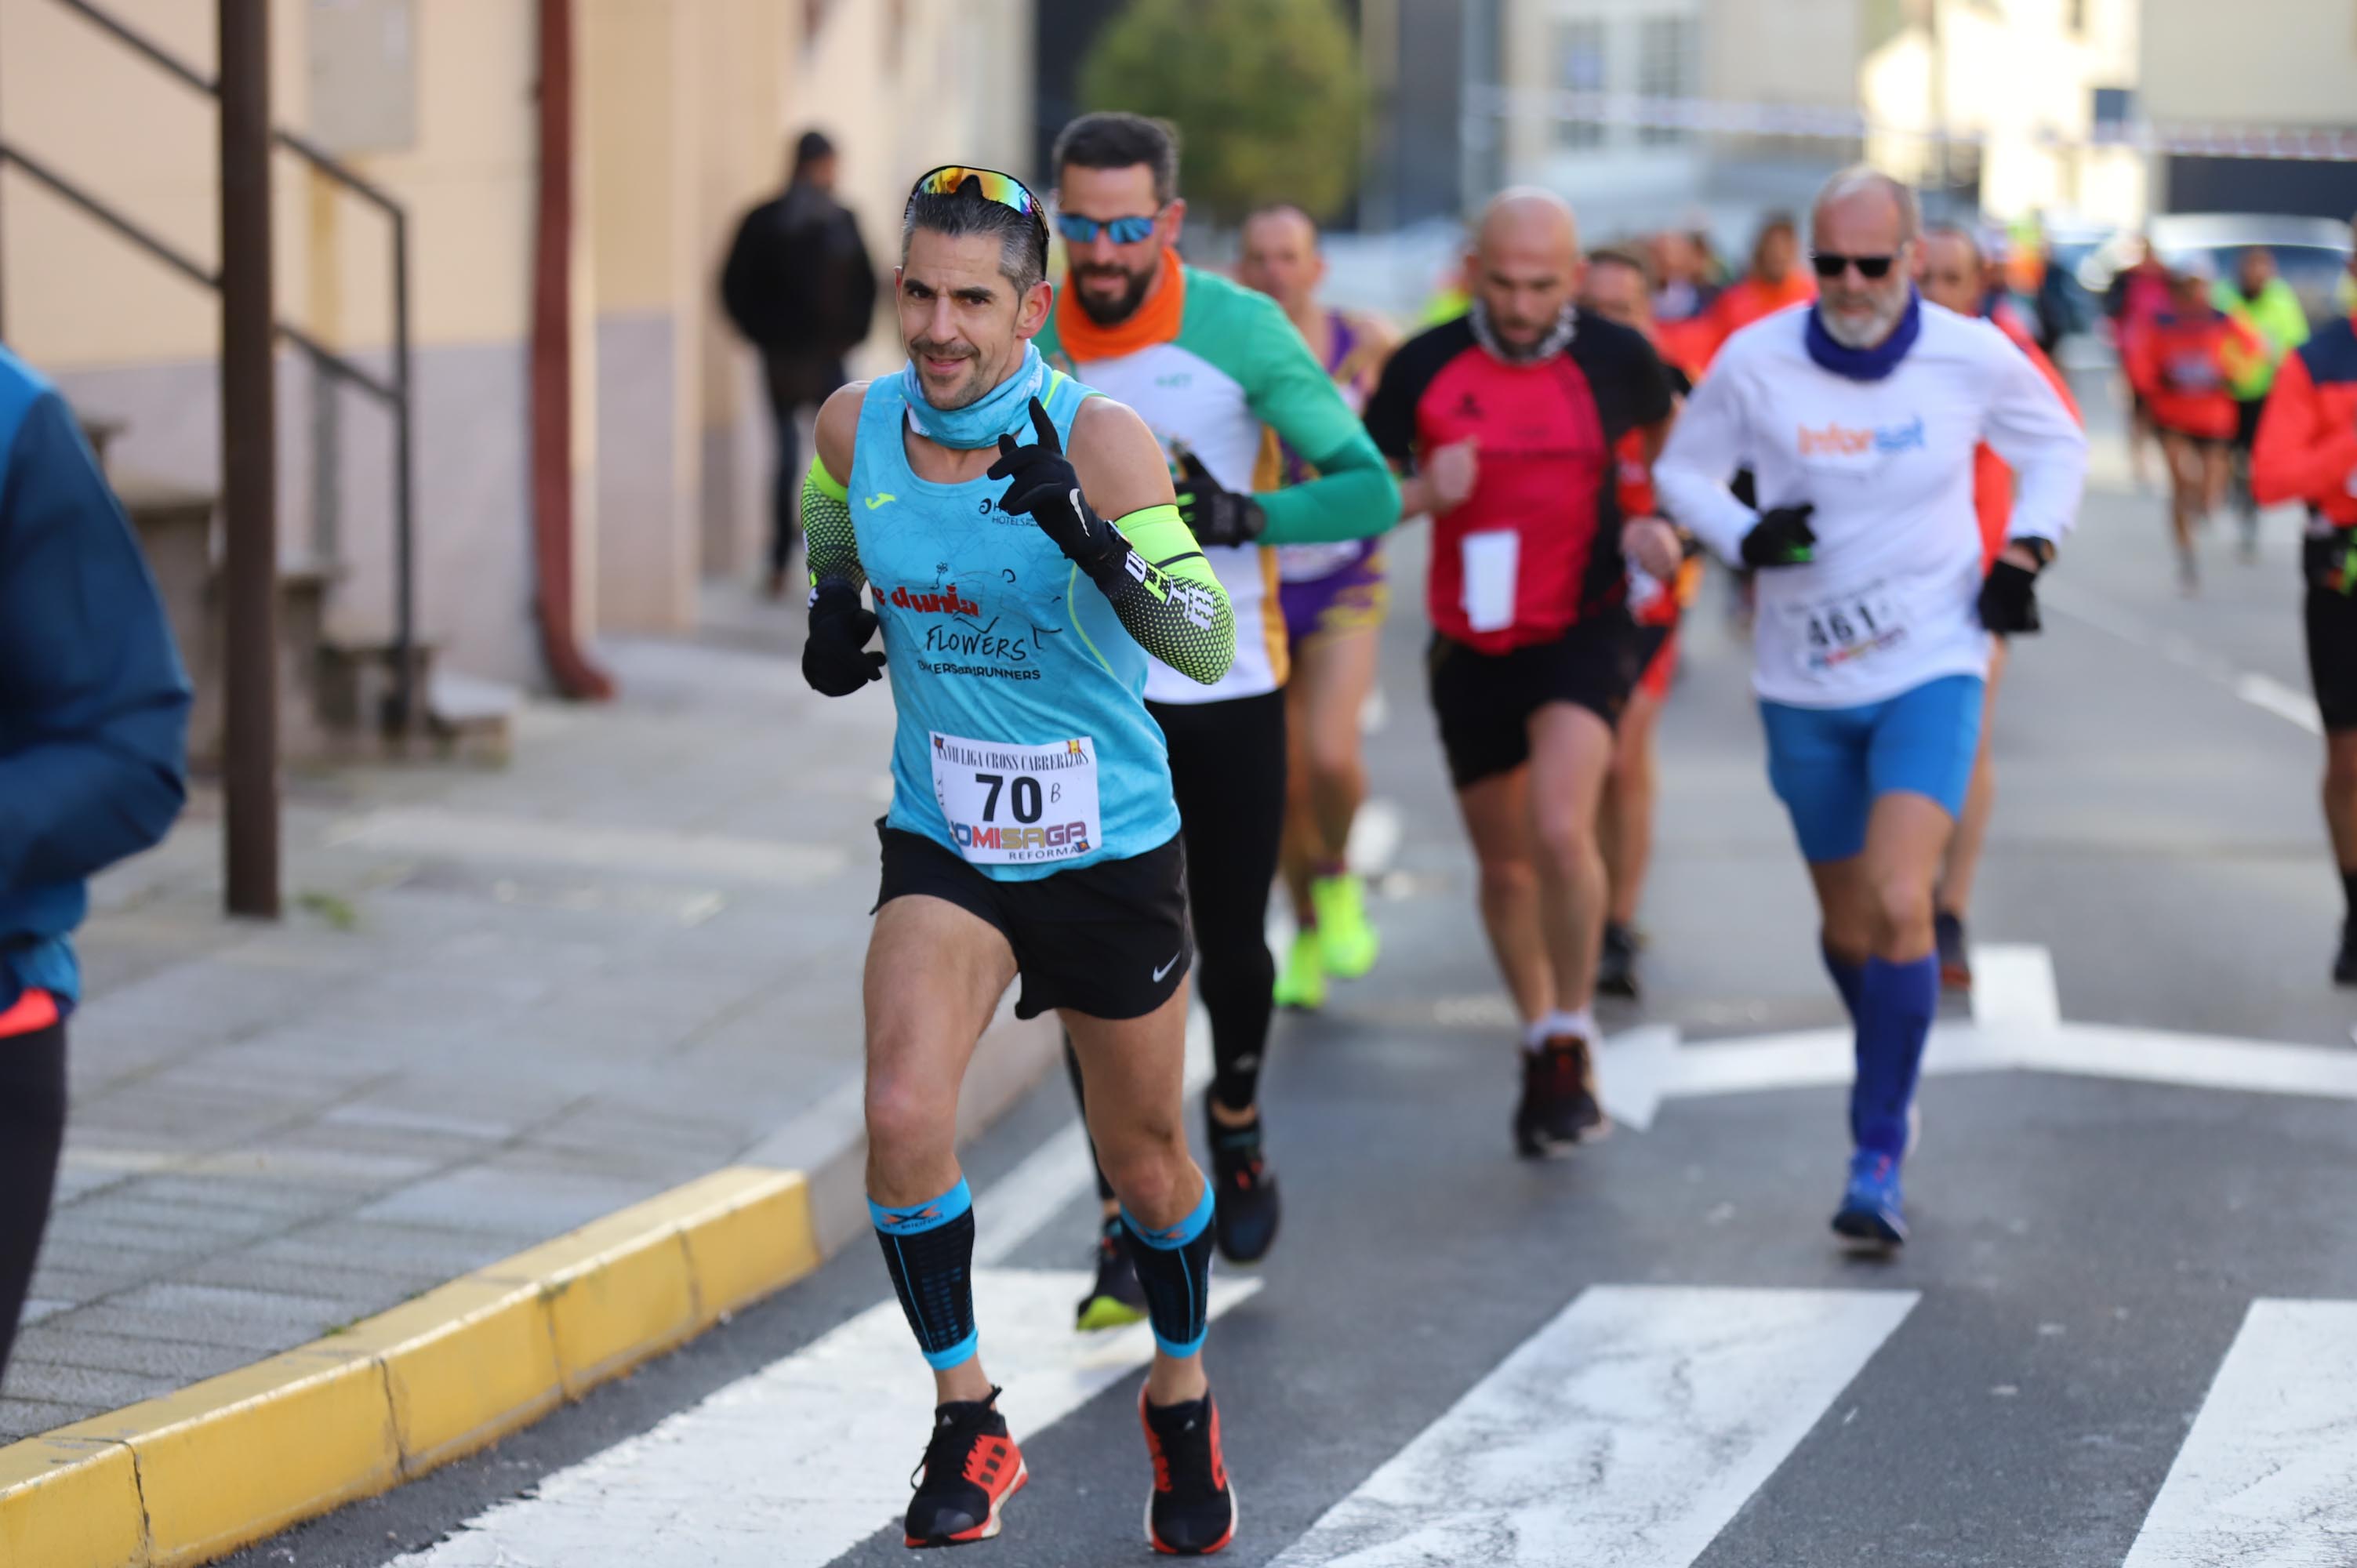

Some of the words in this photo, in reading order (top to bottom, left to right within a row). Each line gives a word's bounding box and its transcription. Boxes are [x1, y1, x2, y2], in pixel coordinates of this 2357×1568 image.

[993, 516, 1025, 526] HOTELS
[927, 625, 1026, 660] FLOWERS
[961, 748, 982, 768] LIGA
[986, 751, 1019, 771] CROSS
[975, 773, 1043, 823] 70
[1051, 782, 1061, 803] B
[950, 821, 1087, 850] OMISAGA
